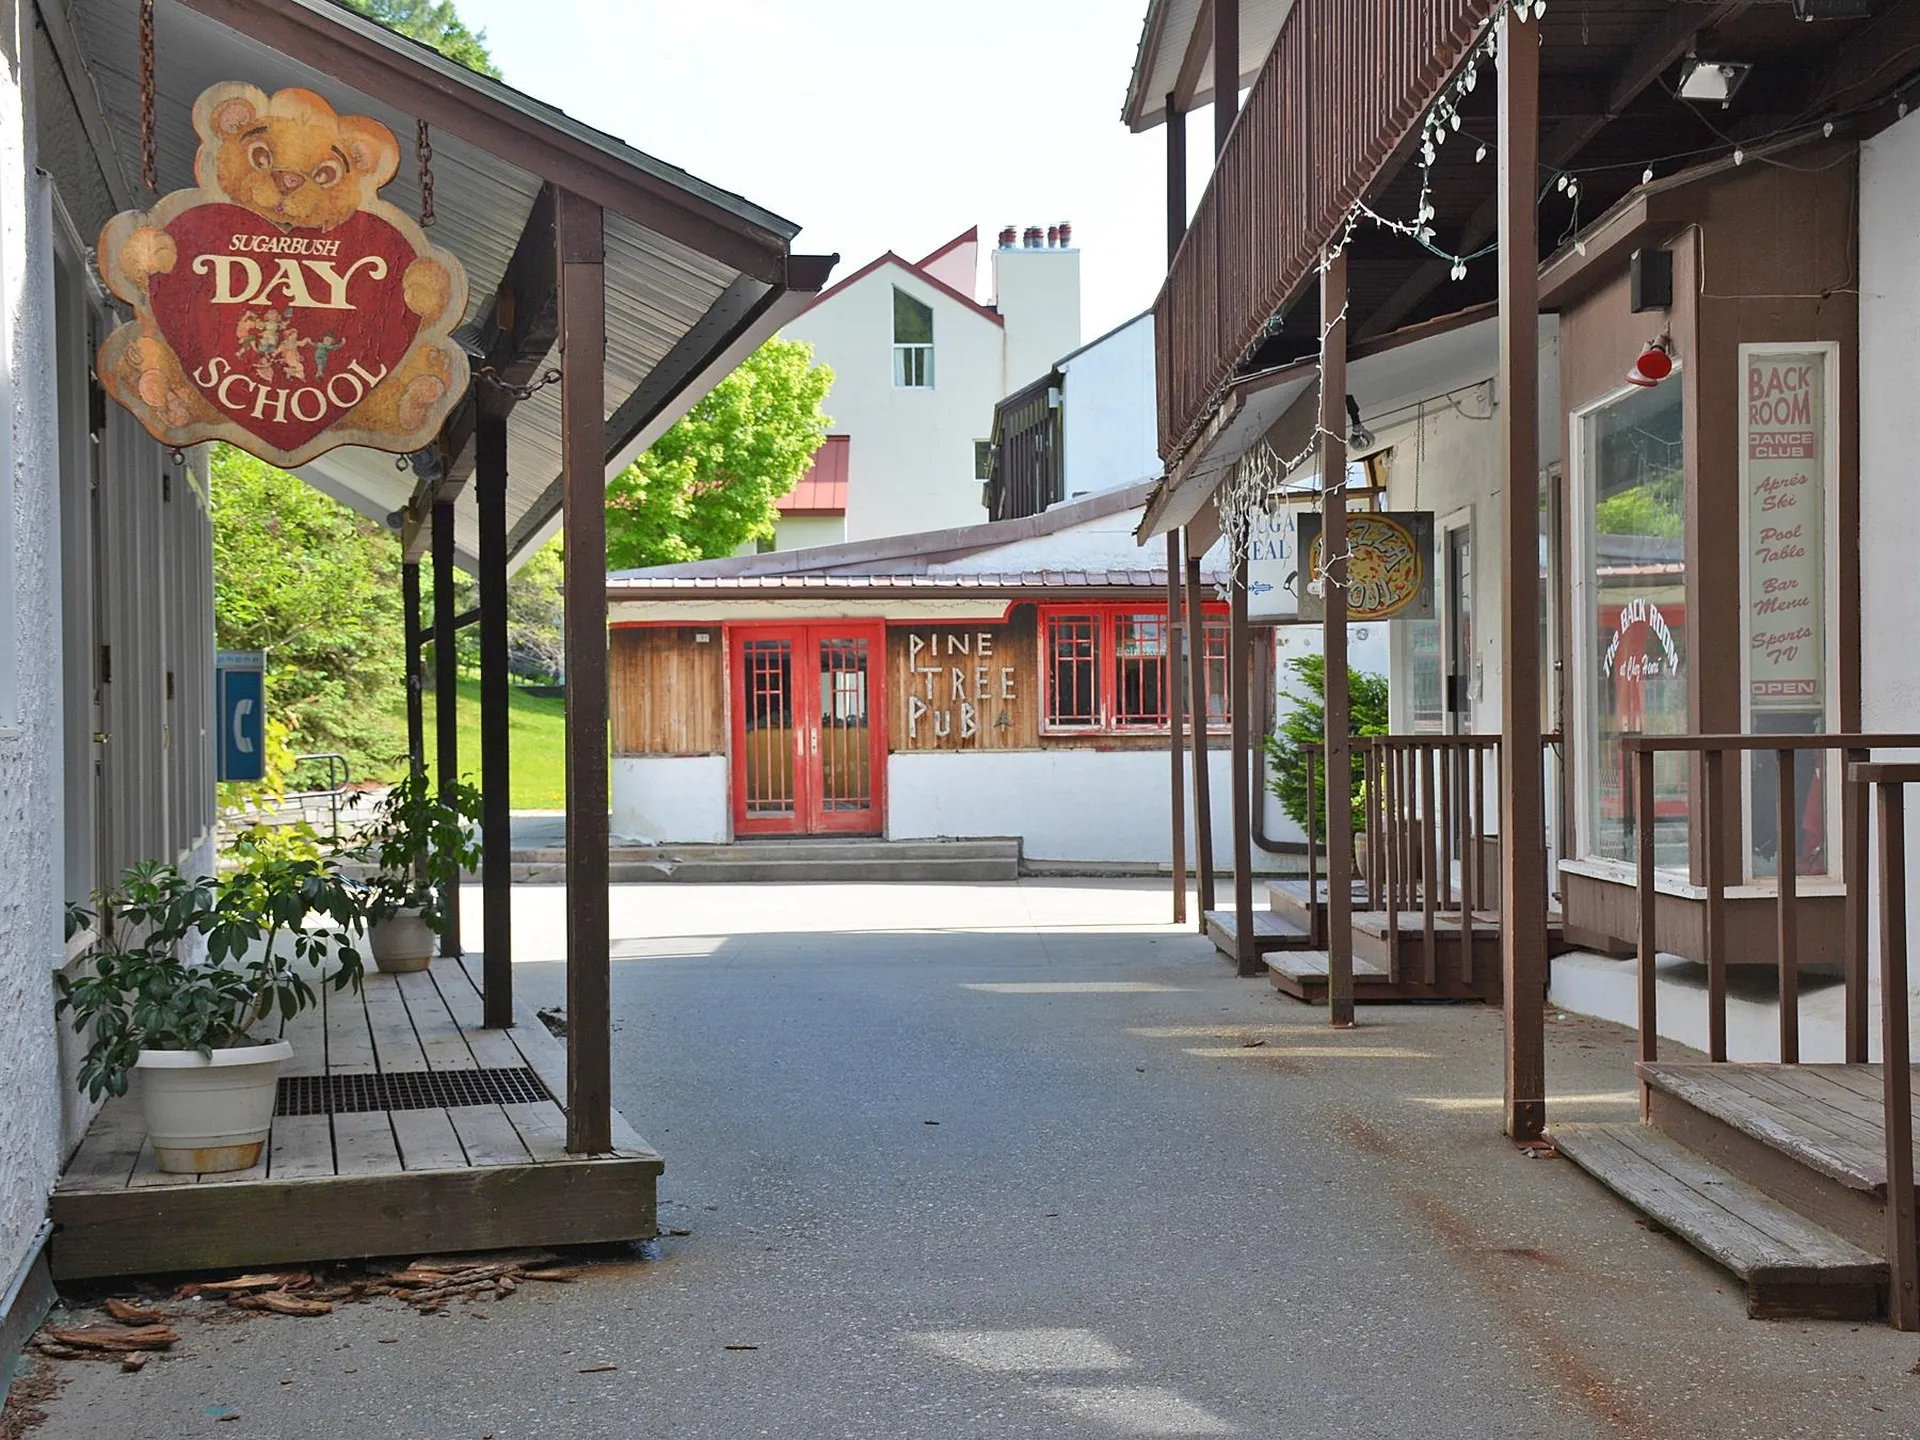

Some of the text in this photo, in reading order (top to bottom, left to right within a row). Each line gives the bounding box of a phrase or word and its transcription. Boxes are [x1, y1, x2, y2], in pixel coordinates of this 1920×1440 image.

[229, 234, 341, 257] SUGARBUSH
[192, 254, 388, 310] DAY
[193, 356, 388, 423] SCHOOL
[1749, 366, 1811, 402] BACK
[1749, 390, 1811, 425] ROOM
[1755, 446, 1805, 458] CLUB
[1761, 493, 1797, 512] Ski
[1759, 524, 1802, 545] Pool
[1754, 545, 1805, 564] Table
[1762, 578, 1800, 594] Bar
[1753, 597, 1810, 616] Menu
[1621, 598, 1646, 634] BACK
[1649, 603, 1679, 677] ROOM
[1752, 627, 1812, 650] Sports
[909, 633, 992, 672] PINE
[1766, 646, 1799, 665] TV
[916, 666, 1017, 701] TREE
[1751, 683, 1814, 693] OPEN
[908, 696, 977, 738] PUB
